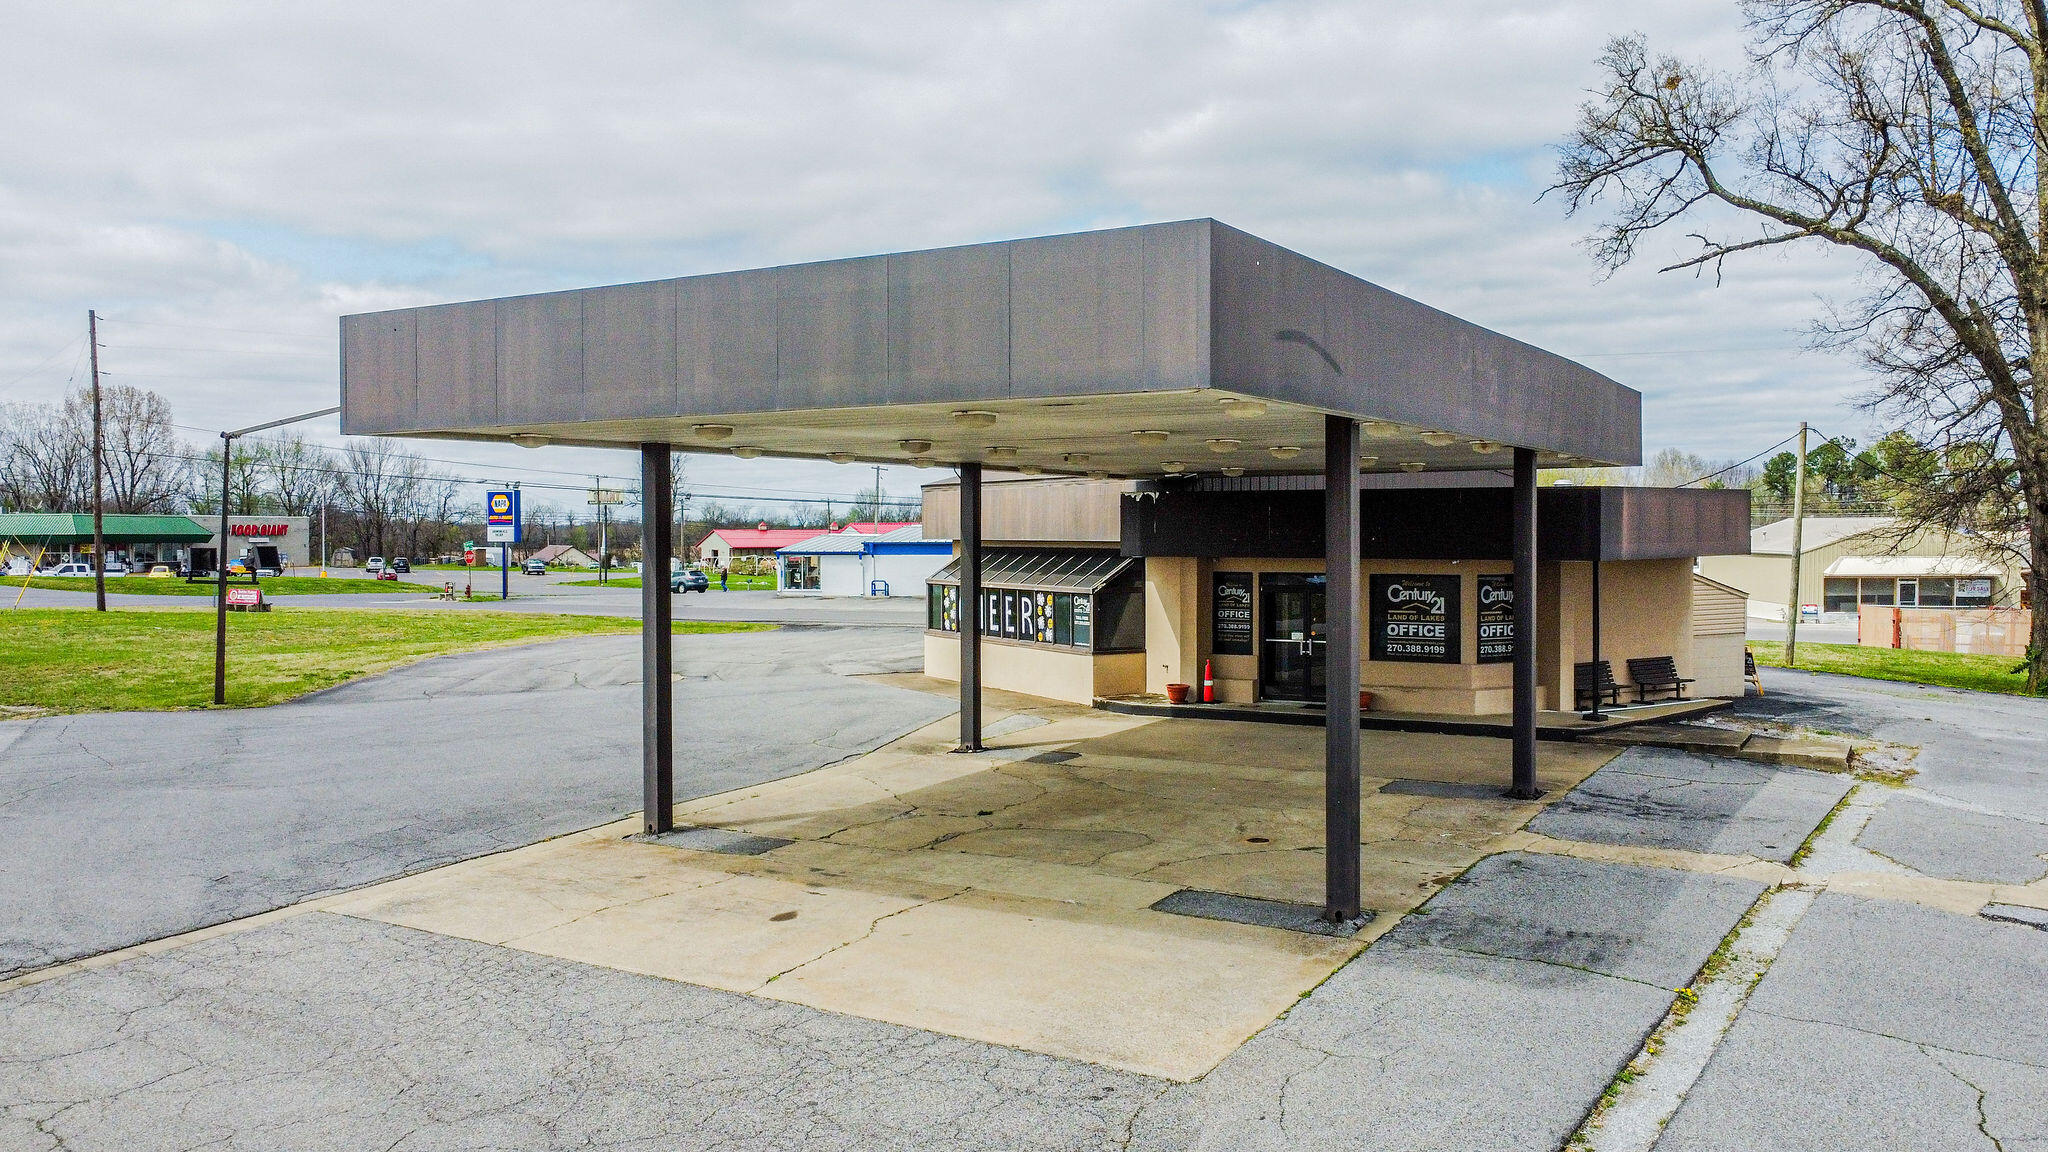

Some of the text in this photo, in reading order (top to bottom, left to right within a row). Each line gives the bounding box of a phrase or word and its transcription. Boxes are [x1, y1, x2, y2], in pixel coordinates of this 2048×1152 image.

[494, 499, 507, 508] NAPA
[231, 525, 288, 536] FOOD GIANT
[1218, 585, 1250, 603] Century 21
[1387, 584, 1445, 614] Century 21
[1218, 610, 1250, 619] OFFICE
[1420, 614, 1445, 622] LAKES
[1387, 624, 1445, 637] OFFICE
[1480, 624, 1514, 637] OFFIC
[1387, 644, 1445, 654] 270.388.9199
[1480, 644, 1514, 654] 270.388.9
